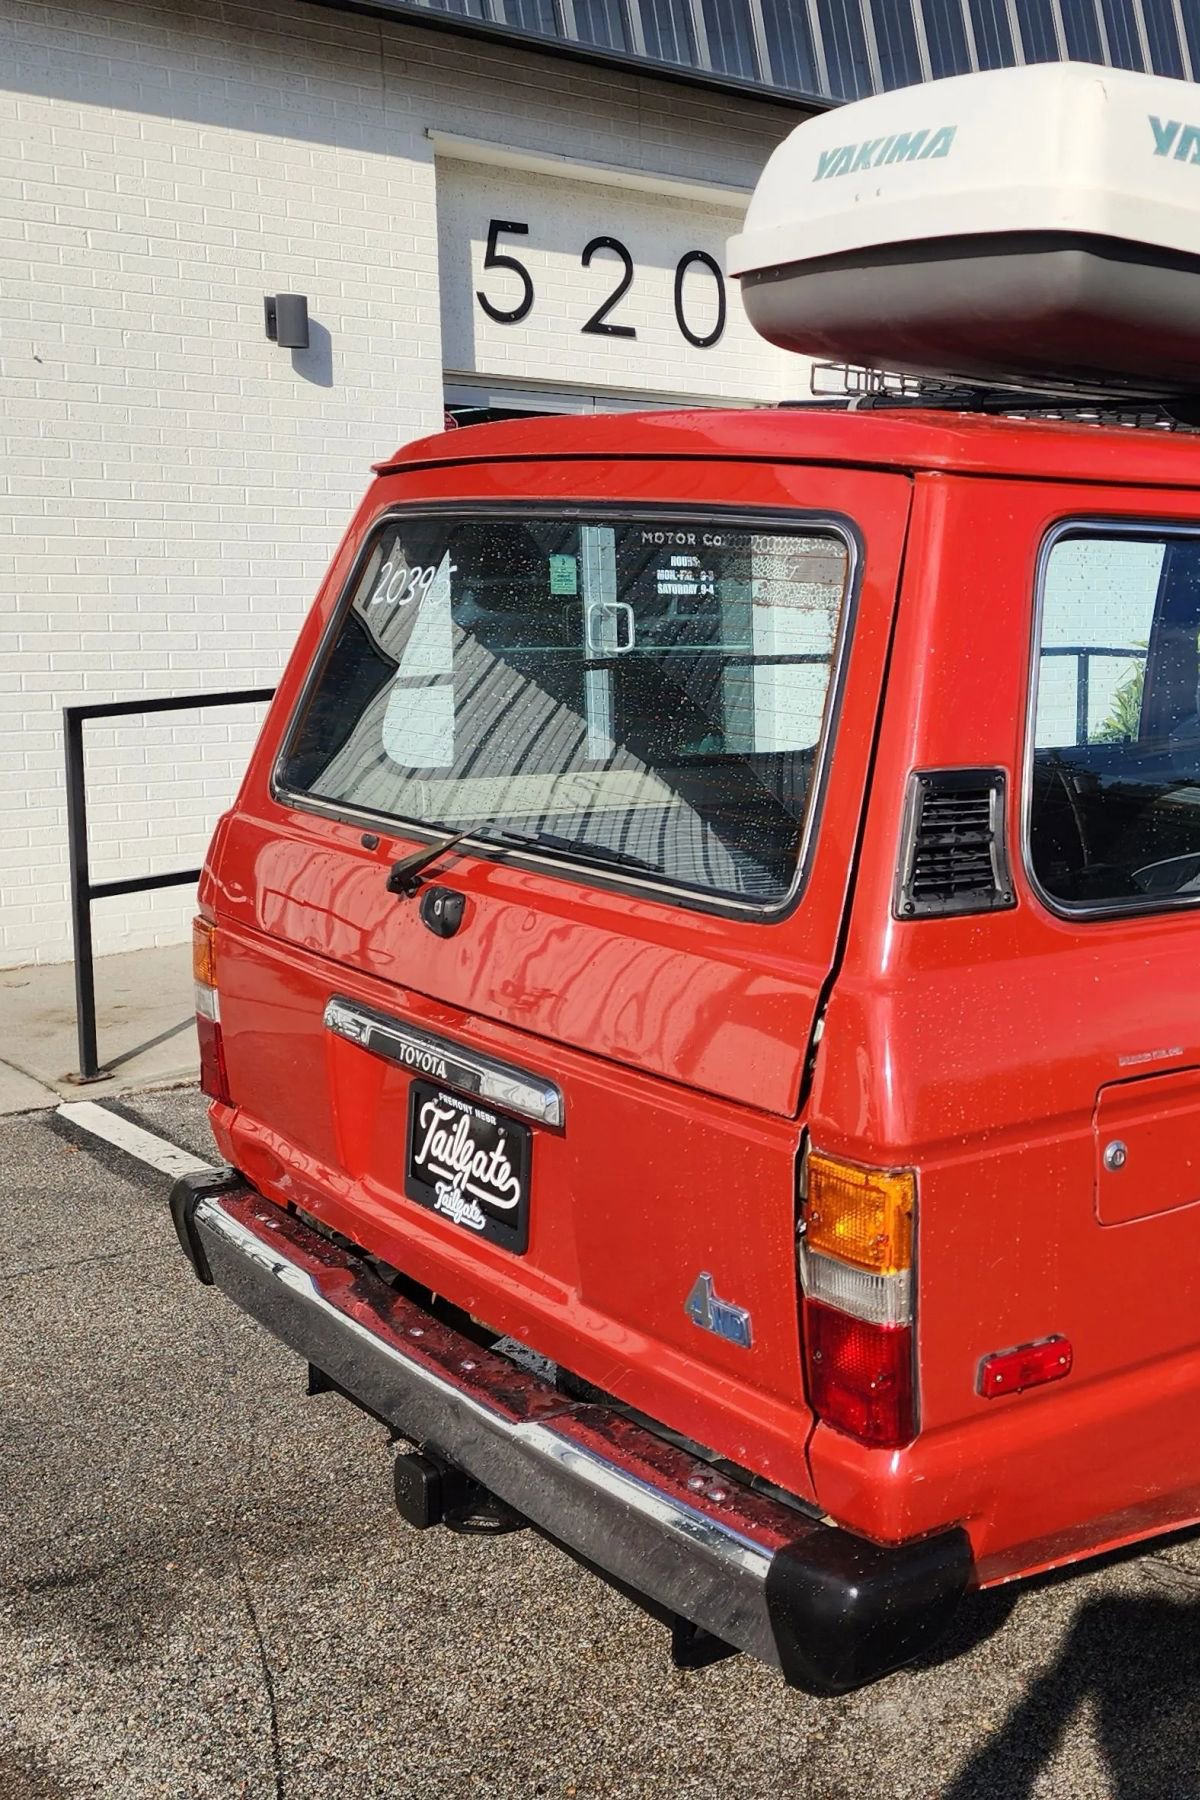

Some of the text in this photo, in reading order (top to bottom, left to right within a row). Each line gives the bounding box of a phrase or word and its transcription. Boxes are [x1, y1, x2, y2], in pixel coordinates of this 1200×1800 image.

[812, 125, 958, 182] YAKIMA
[476, 219, 726, 348] 520
[641, 532, 697, 546] MOTOR
[657, 583, 698, 595] SATURDAY
[399, 1043, 447, 1079] TOYOTA
[438, 1092, 474, 1116] FREMONT
[414, 1101, 520, 1209] Tailgate
[434, 1181, 486, 1230] Tailgate
